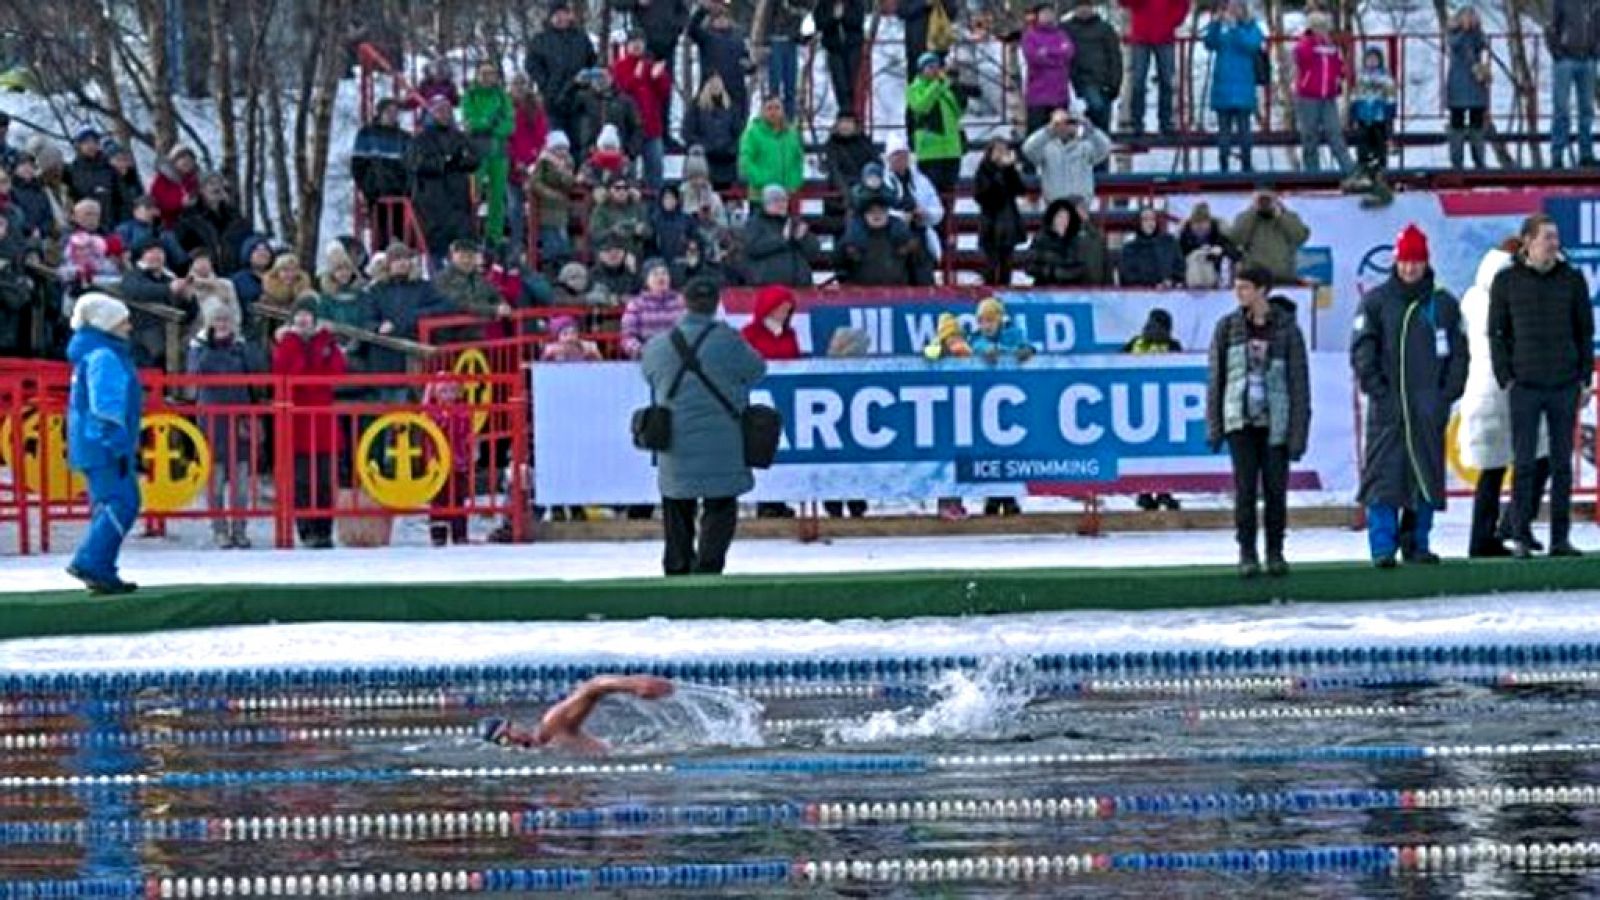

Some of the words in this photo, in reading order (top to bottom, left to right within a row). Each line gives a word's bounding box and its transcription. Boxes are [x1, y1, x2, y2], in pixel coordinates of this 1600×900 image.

[904, 312, 1077, 353] WLD
[1058, 382, 1208, 445] CUP
[974, 460, 1001, 478] ICE
[1005, 458, 1100, 478] SWIMMING
